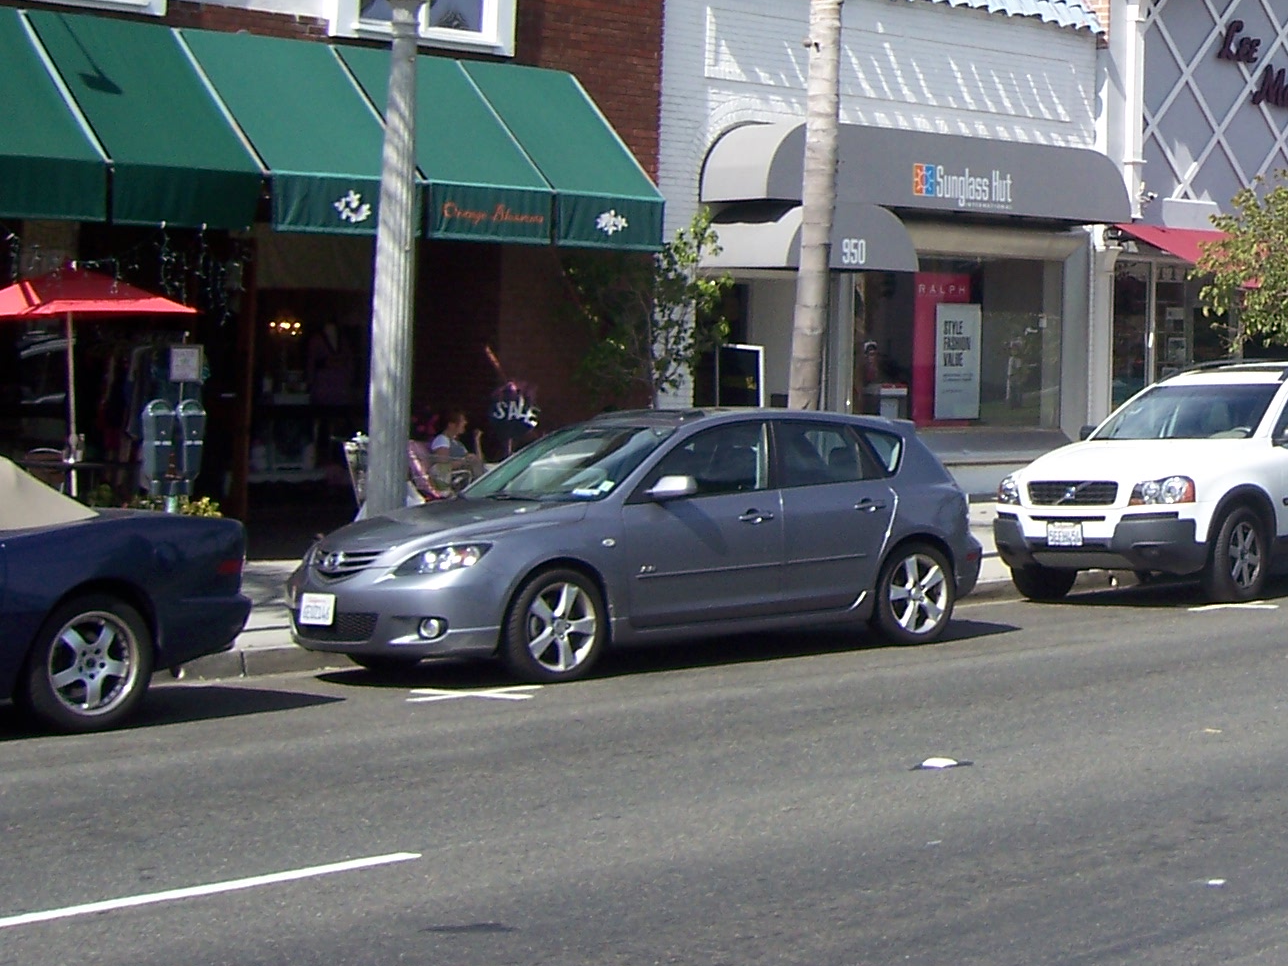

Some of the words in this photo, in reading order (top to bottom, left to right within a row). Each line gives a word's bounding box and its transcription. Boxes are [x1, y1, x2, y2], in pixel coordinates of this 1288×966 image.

[936, 165, 989, 207] Sunglass
[992, 169, 1012, 203] Hut
[441, 201, 487, 226] Orange
[842, 238, 866, 264] 950
[918, 284, 966, 294] RALPH
[943, 320, 963, 335] STYLE
[943, 352, 963, 367] VALUE
[493, 395, 541, 427] SALE
